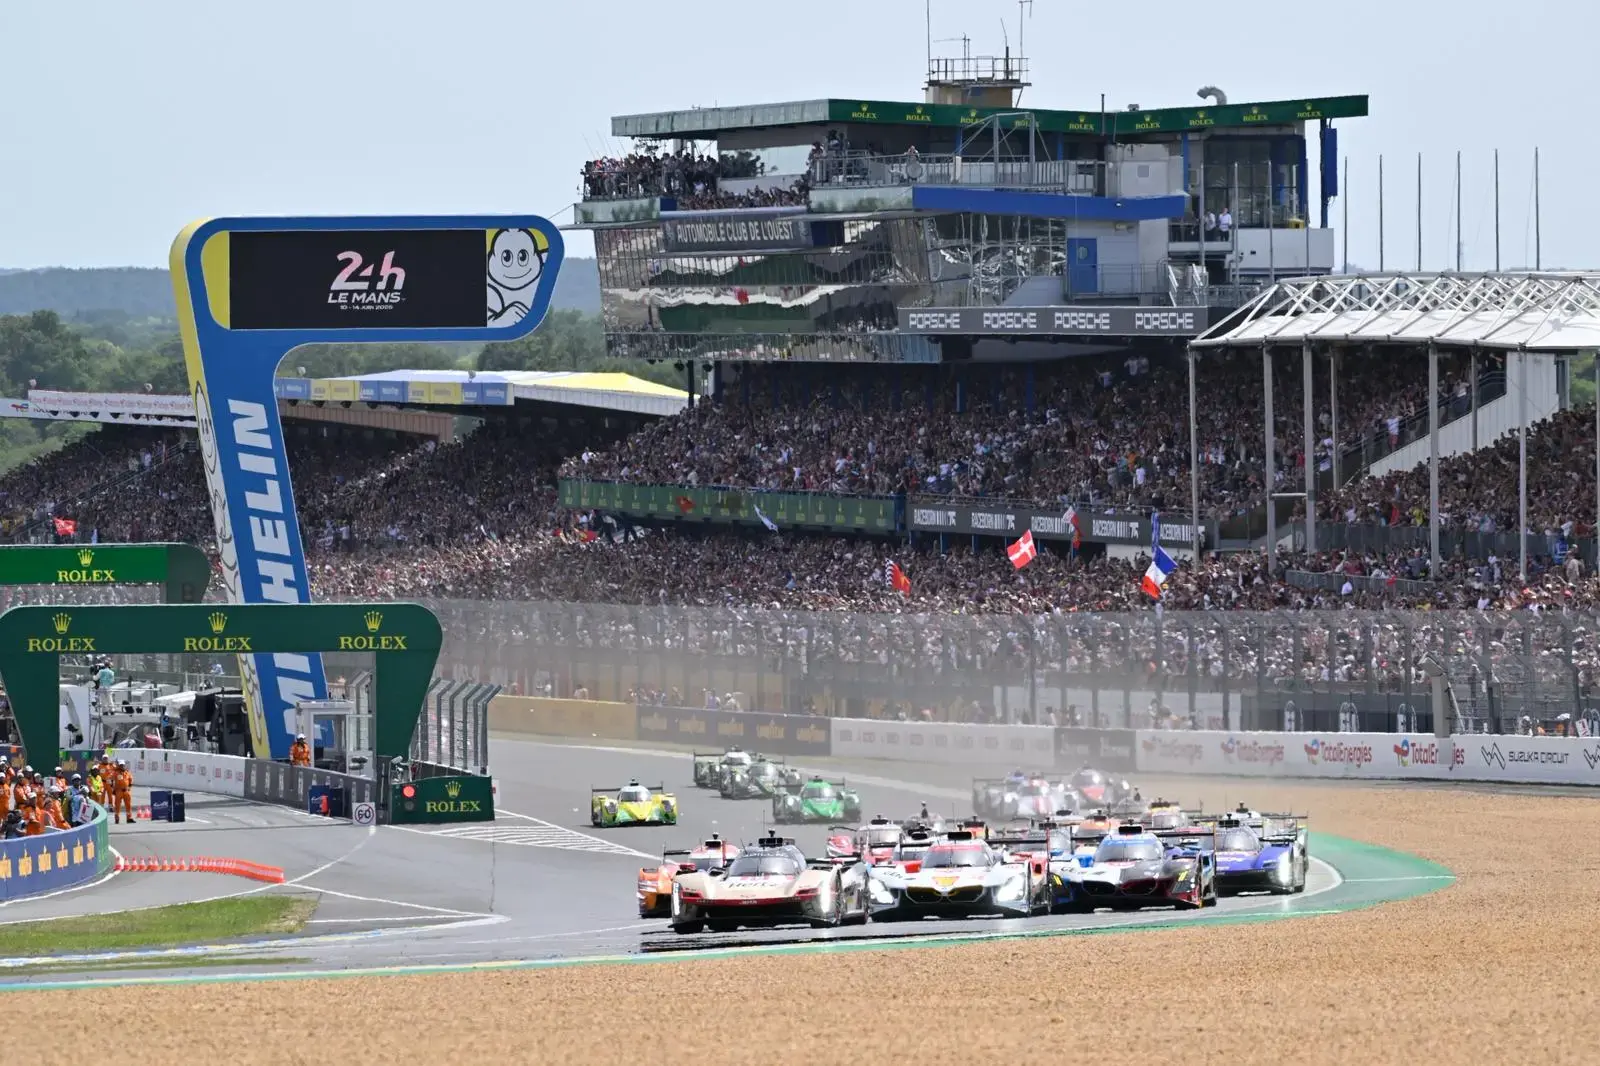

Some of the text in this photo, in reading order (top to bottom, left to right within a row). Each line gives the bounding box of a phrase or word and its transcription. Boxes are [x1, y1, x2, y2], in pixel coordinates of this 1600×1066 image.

[852, 112, 877, 120] ROLEX
[906, 114, 932, 122] ROLEX
[960, 115, 985, 125] ROLE
[1243, 114, 1268, 122] ROLEX
[1297, 110, 1322, 118] ROLEX
[1069, 122, 1095, 131] ROLEX
[1135, 122, 1161, 130] ROLEX
[1189, 119, 1215, 127] ROLEX
[677, 220, 794, 243] AUTOMOBILE CLUB DE L'OUEST
[330, 250, 406, 290] 24h
[327, 292, 401, 303] LE MANS
[909, 312, 1194, 330] PORSCHE PORSCHE PORSCHE PORSCHE
[227, 398, 323, 740] MIHELIN
[57, 569, 115, 582] ROLEX
[28, 636, 407, 651] ROLEX ROLEX ROLEX
[1320, 741, 1372, 768] TotalEnergies
[1411, 742, 1465, 771] TotalEies
[1508, 751, 1570, 765] SUZUKA CIRCUIT
[426, 801, 481, 813] ROLEX
